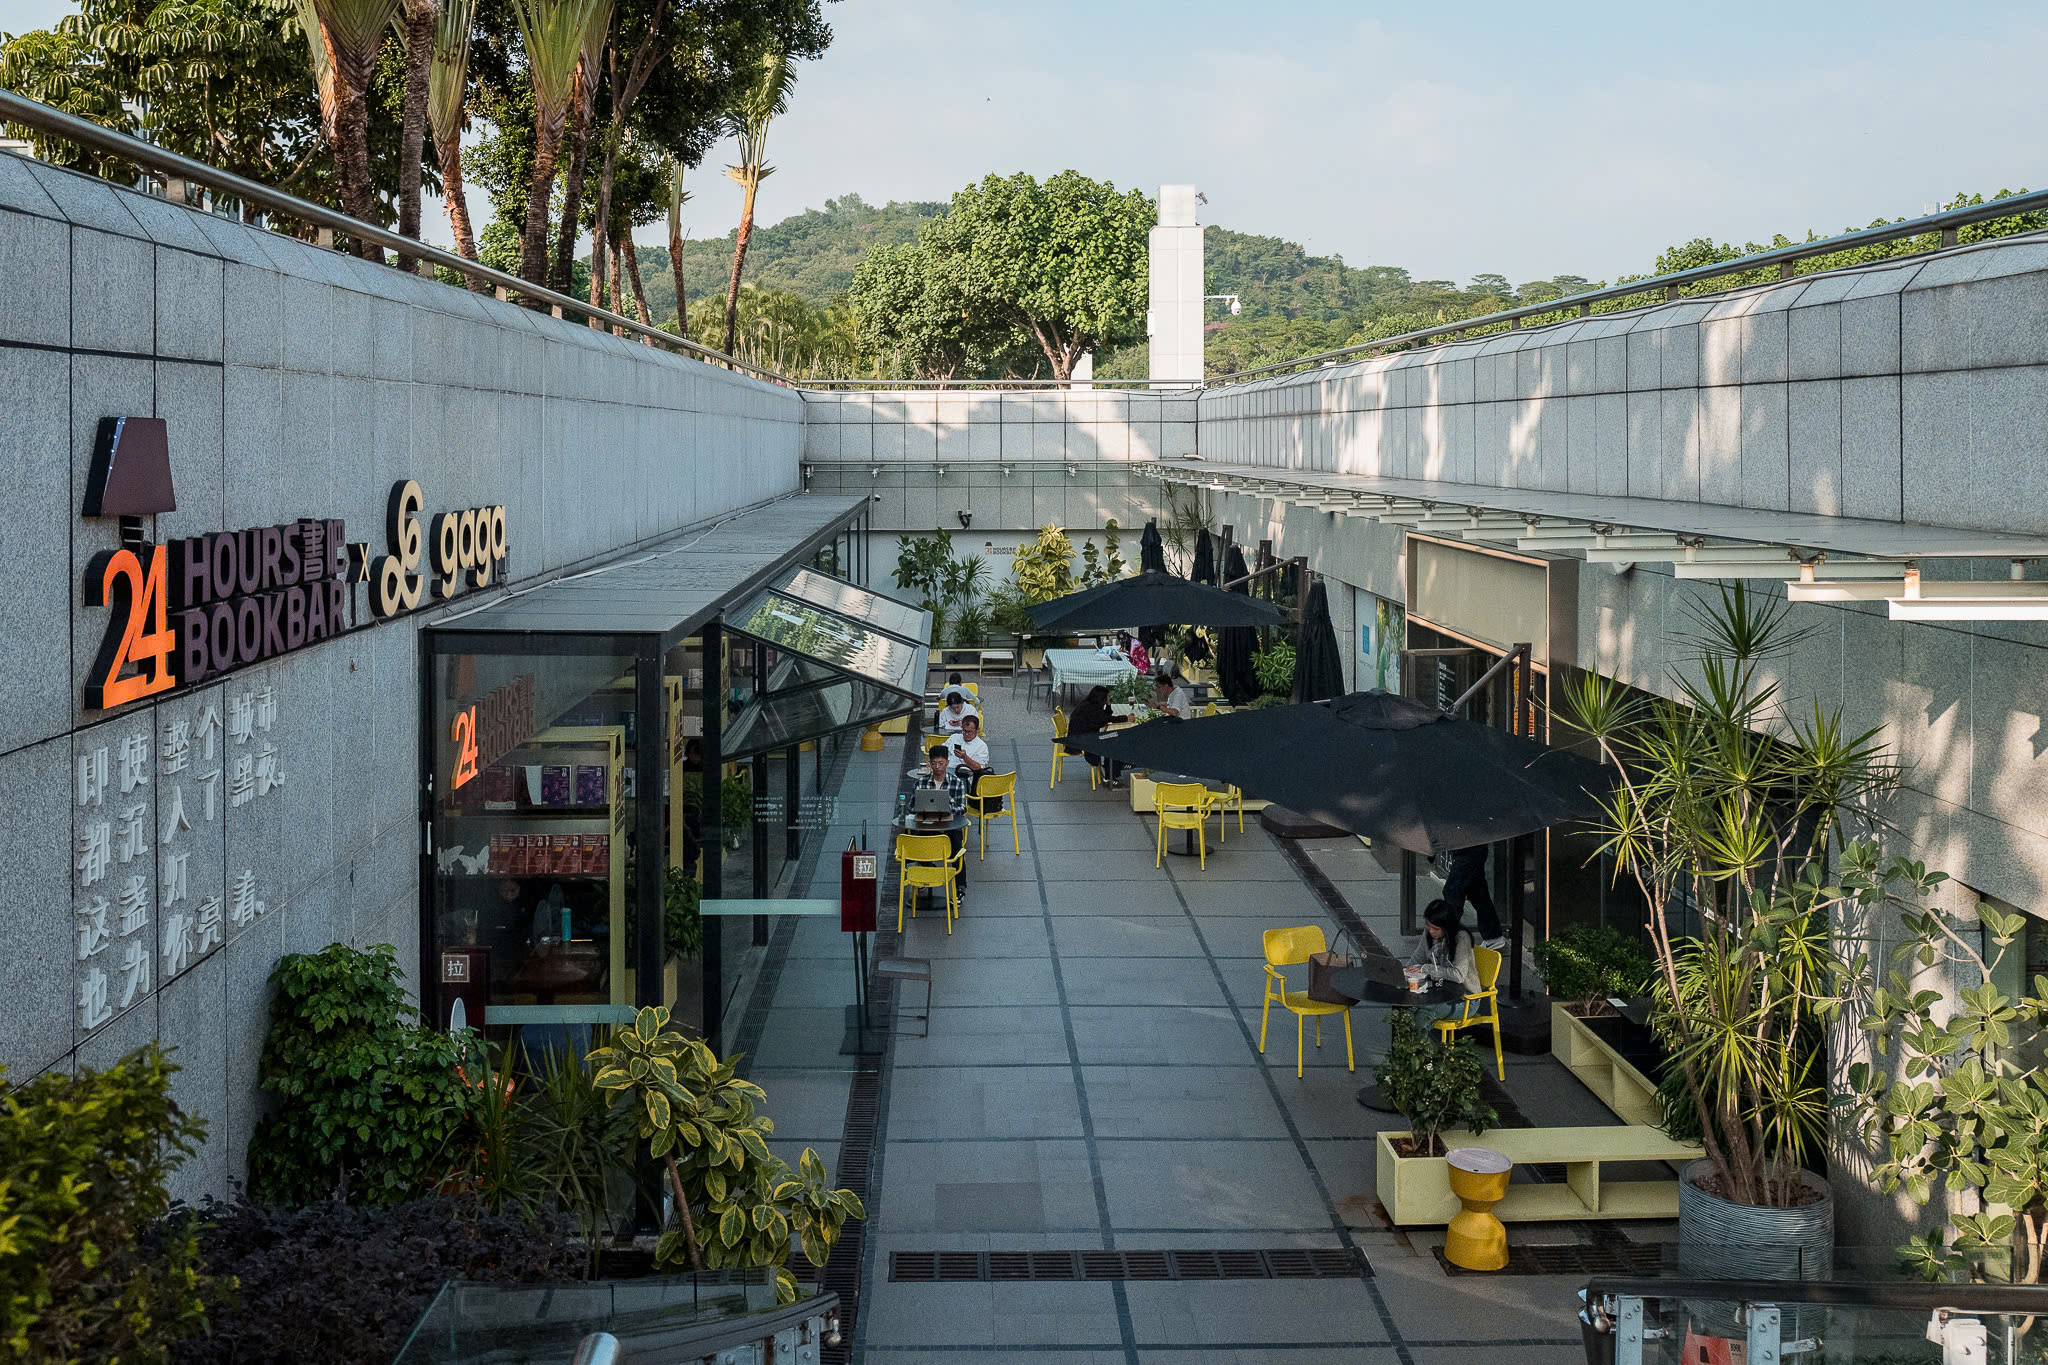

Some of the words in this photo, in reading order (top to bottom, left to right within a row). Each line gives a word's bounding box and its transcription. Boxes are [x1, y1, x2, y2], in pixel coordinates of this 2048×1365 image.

[183, 523, 300, 607] HOURS
[303, 518, 345, 581] 書吧
[440, 505, 506, 599] gaga
[102, 544, 176, 710] 24
[183, 579, 346, 683] BOOKBAR
[858, 860, 872, 874] 拉
[447, 960, 464, 977] 拉
